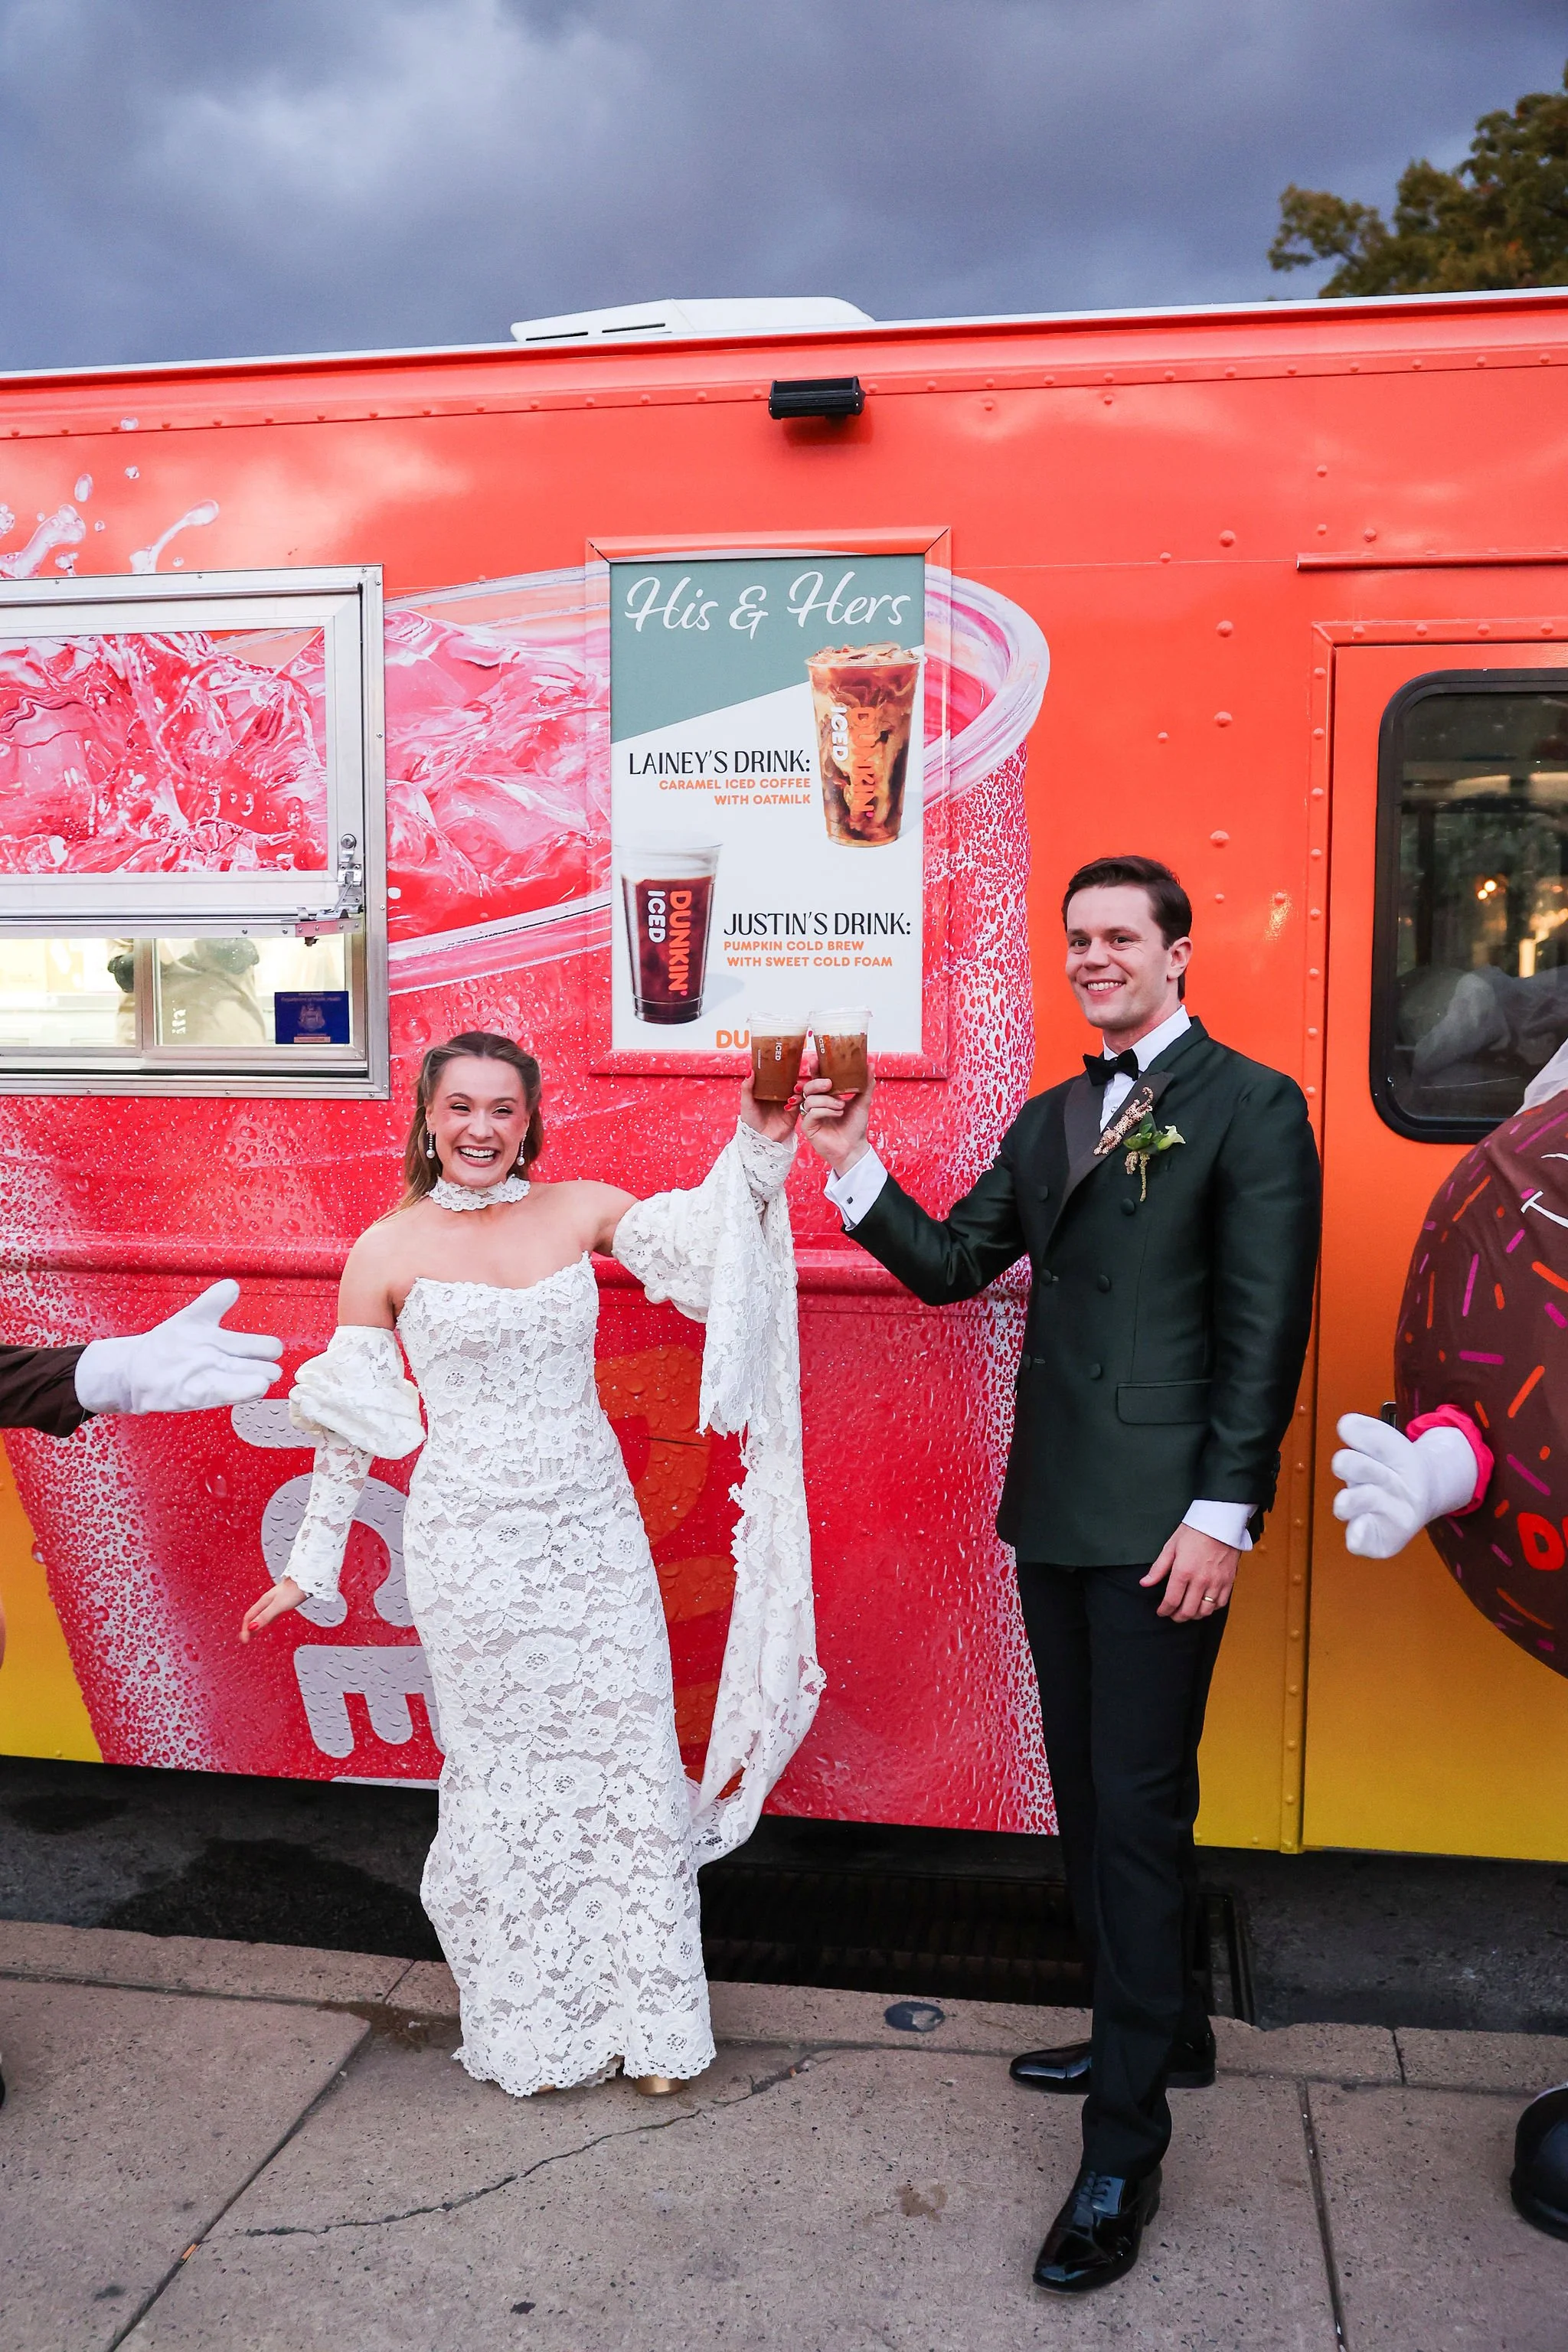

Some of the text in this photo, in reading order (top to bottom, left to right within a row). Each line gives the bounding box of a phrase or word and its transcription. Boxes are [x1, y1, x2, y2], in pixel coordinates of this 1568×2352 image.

[625, 570, 911, 640] His & Hers
[830, 704, 849, 761] ICED
[629, 749, 812, 775] LAINEY'S DRINK:
[658, 777, 811, 790] CARAMEL ICED COFFEE
[714, 793, 811, 805] WITH OATMILK
[648, 890, 666, 943] ICED
[724, 912, 912, 936] JUSTIN'S DRINK:
[668, 890, 692, 996] DUNKIN'
[724, 940, 864, 952] PUMPKIN COLD BREW
[727, 956, 893, 968] WITH SWEET COLD FOAM
[774, 1041, 782, 1062] ICED
